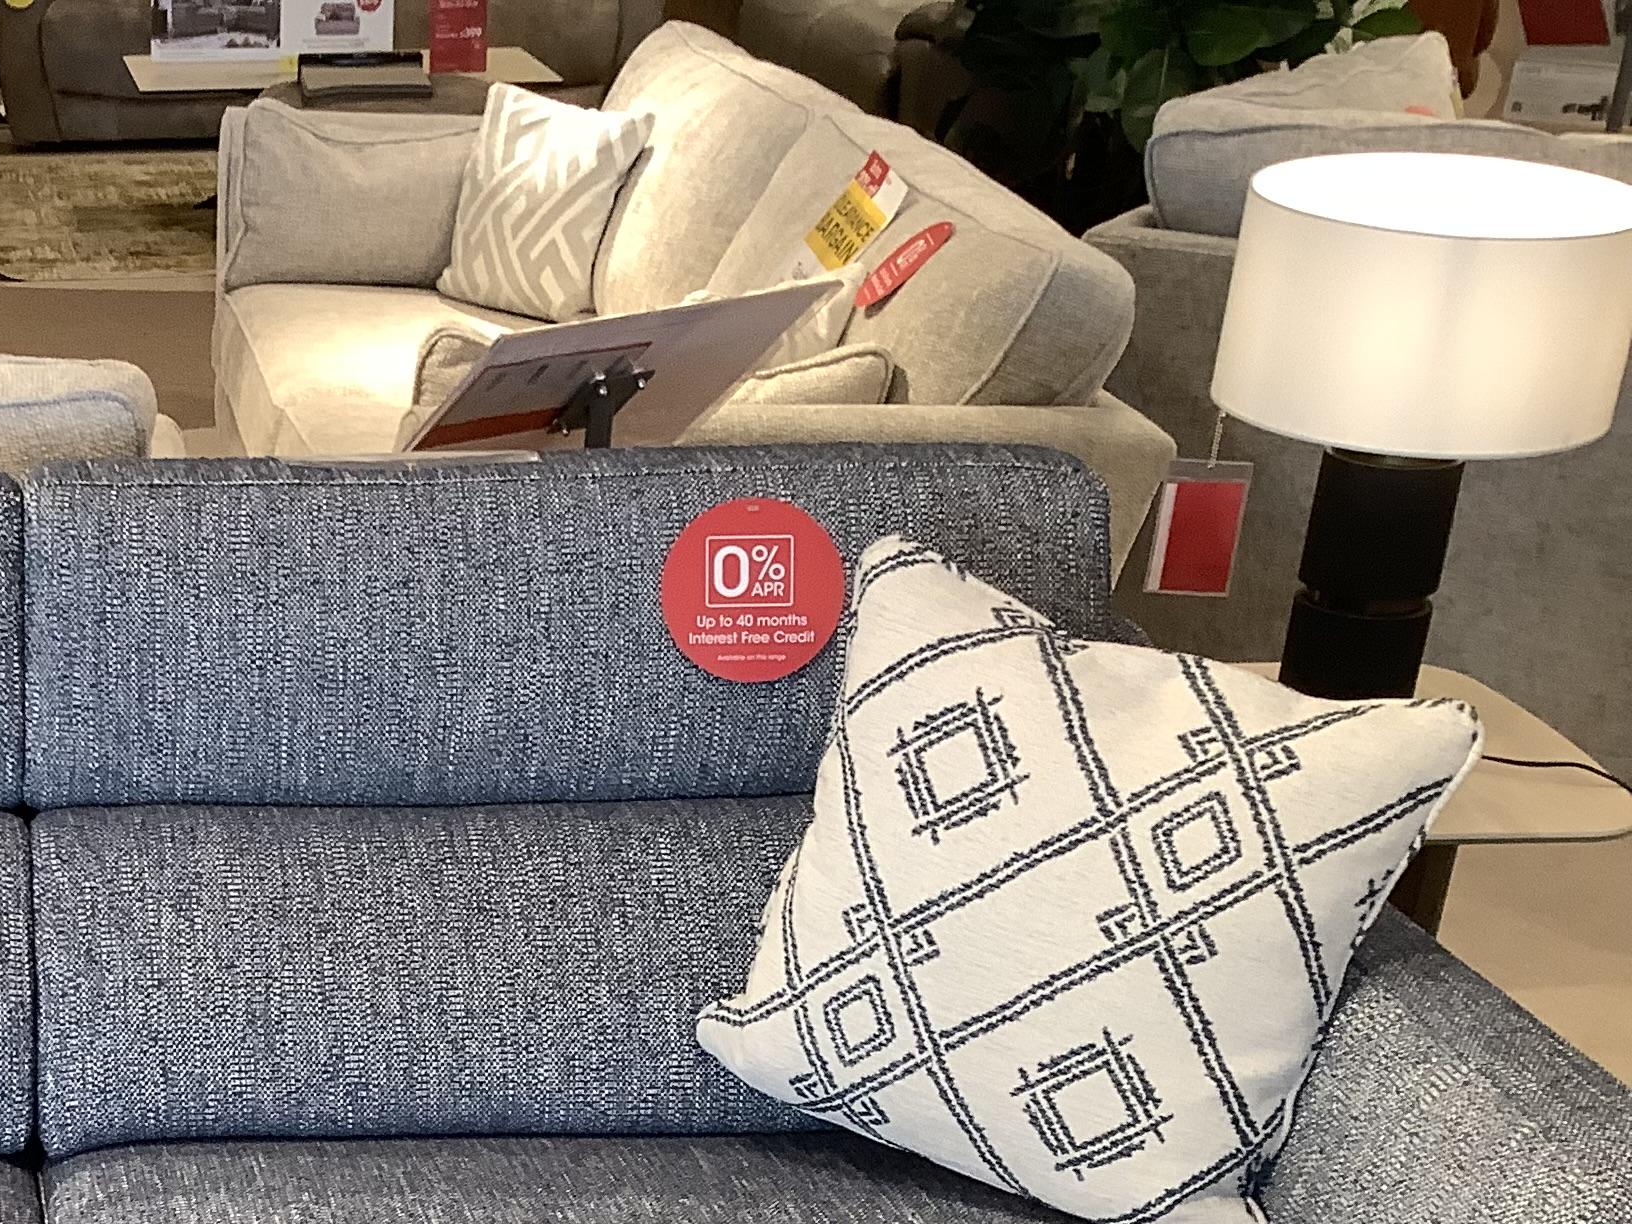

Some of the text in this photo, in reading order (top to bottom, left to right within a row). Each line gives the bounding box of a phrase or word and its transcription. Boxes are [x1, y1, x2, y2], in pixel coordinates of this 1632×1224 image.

[713, 545, 786, 598] 0%
[751, 582, 784, 597] APR
[697, 614, 808, 629] Up to 40 months
[689, 631, 815, 645] Interest Free Credit
